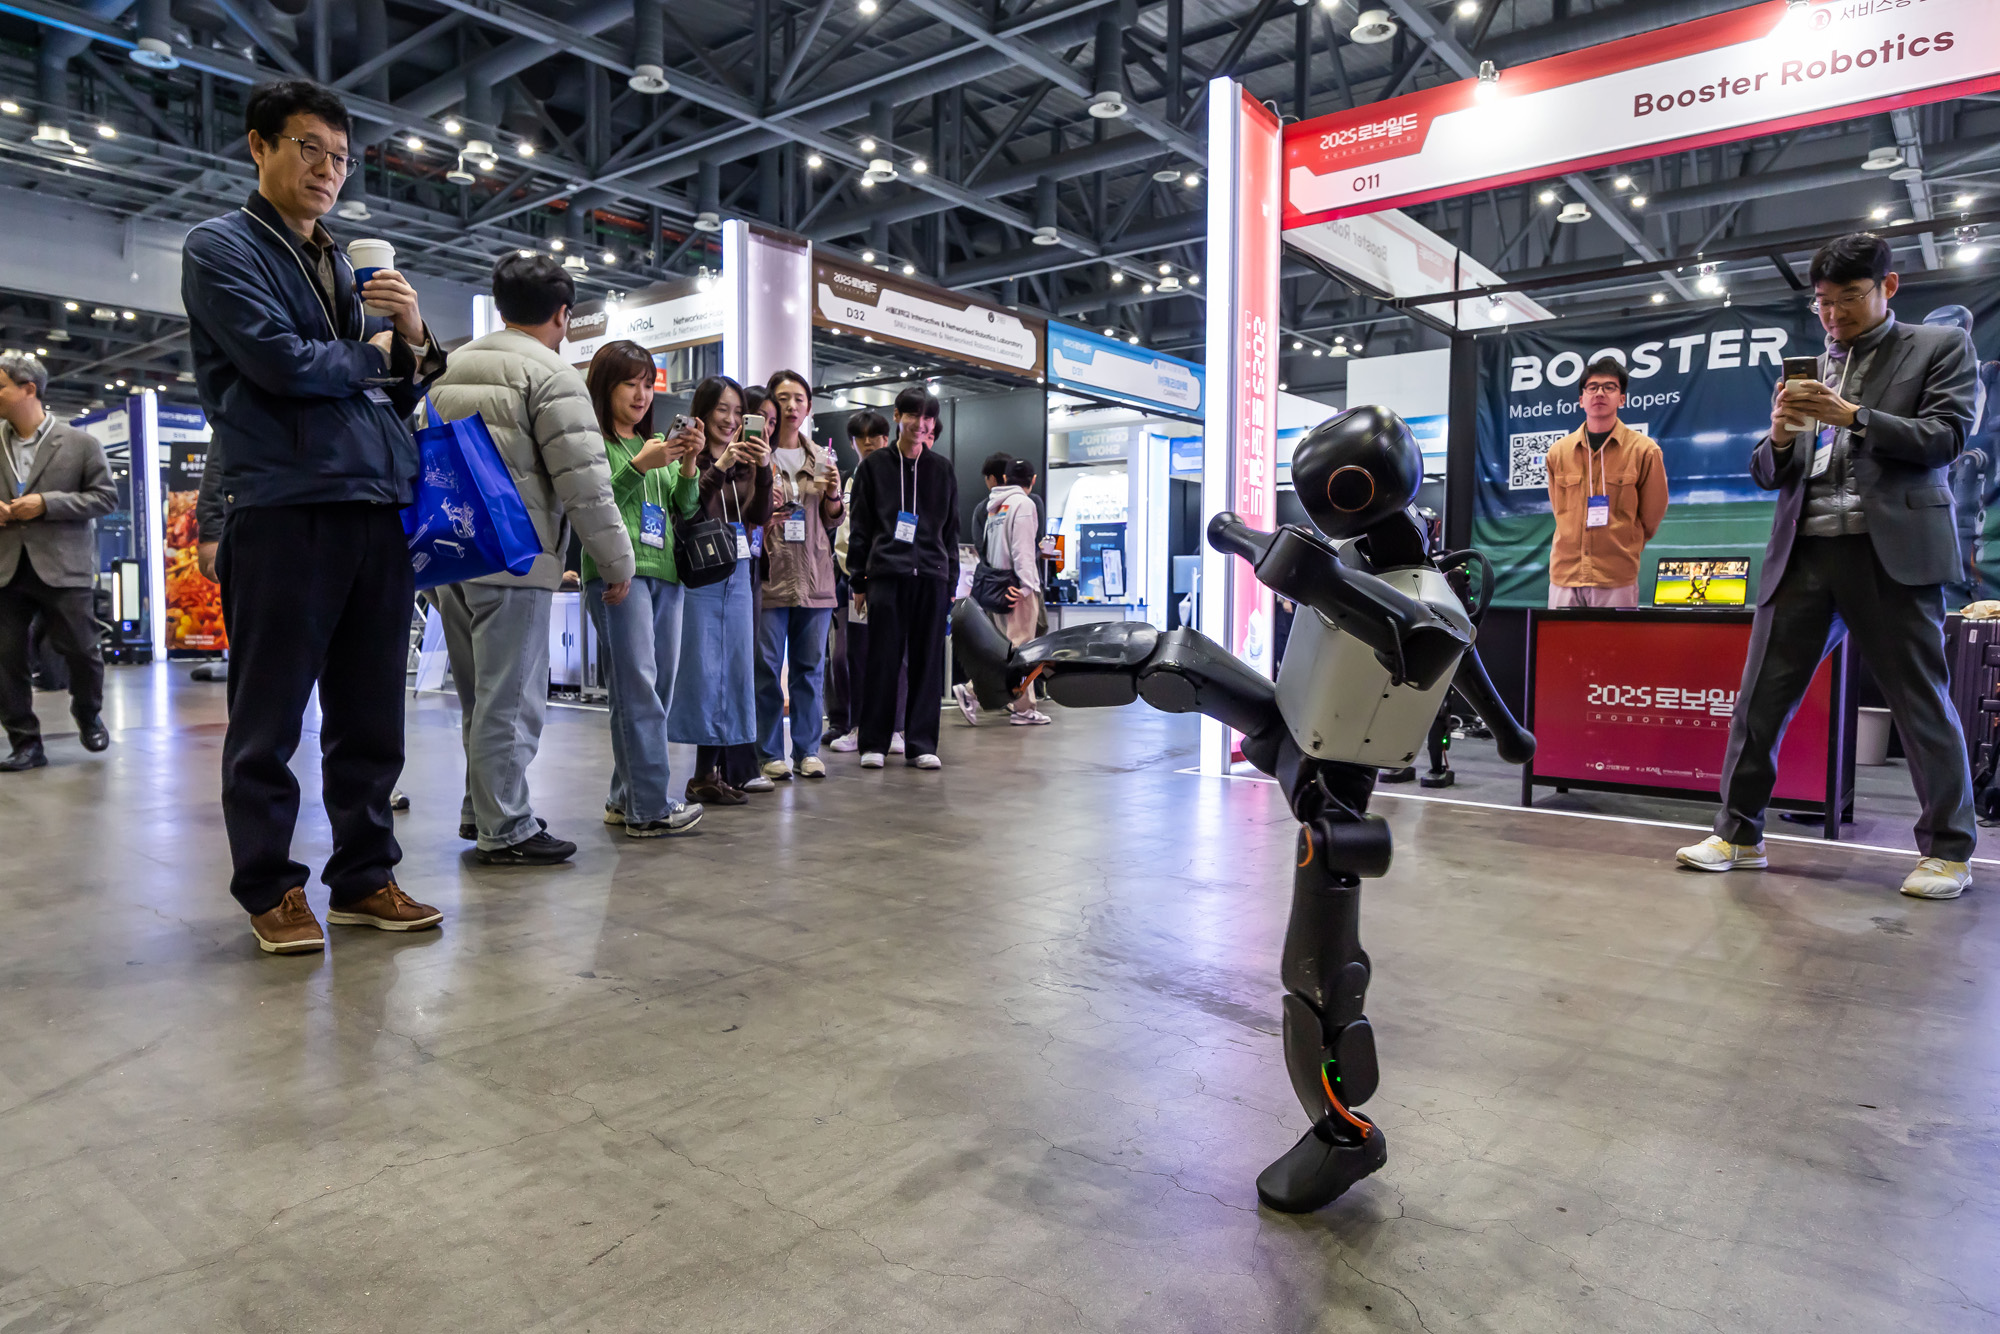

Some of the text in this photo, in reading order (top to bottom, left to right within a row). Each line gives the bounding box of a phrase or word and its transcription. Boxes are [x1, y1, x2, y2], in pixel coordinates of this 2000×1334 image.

[1633, 31, 1955, 118] Booster Robotics
[673, 312, 708, 326] Networked
[846, 307, 865, 321] D32
[911, 312, 940, 327] Interactive
[941, 320, 945, 328] &
[946, 322, 975, 336] Networked
[975, 329, 997, 341] Robotics
[997, 335, 1023, 350] Laboratory
[1509, 401, 1553, 419] Made
[1556, 399, 1580, 415] for
[1587, 684, 1741, 717] 2025 로보월
